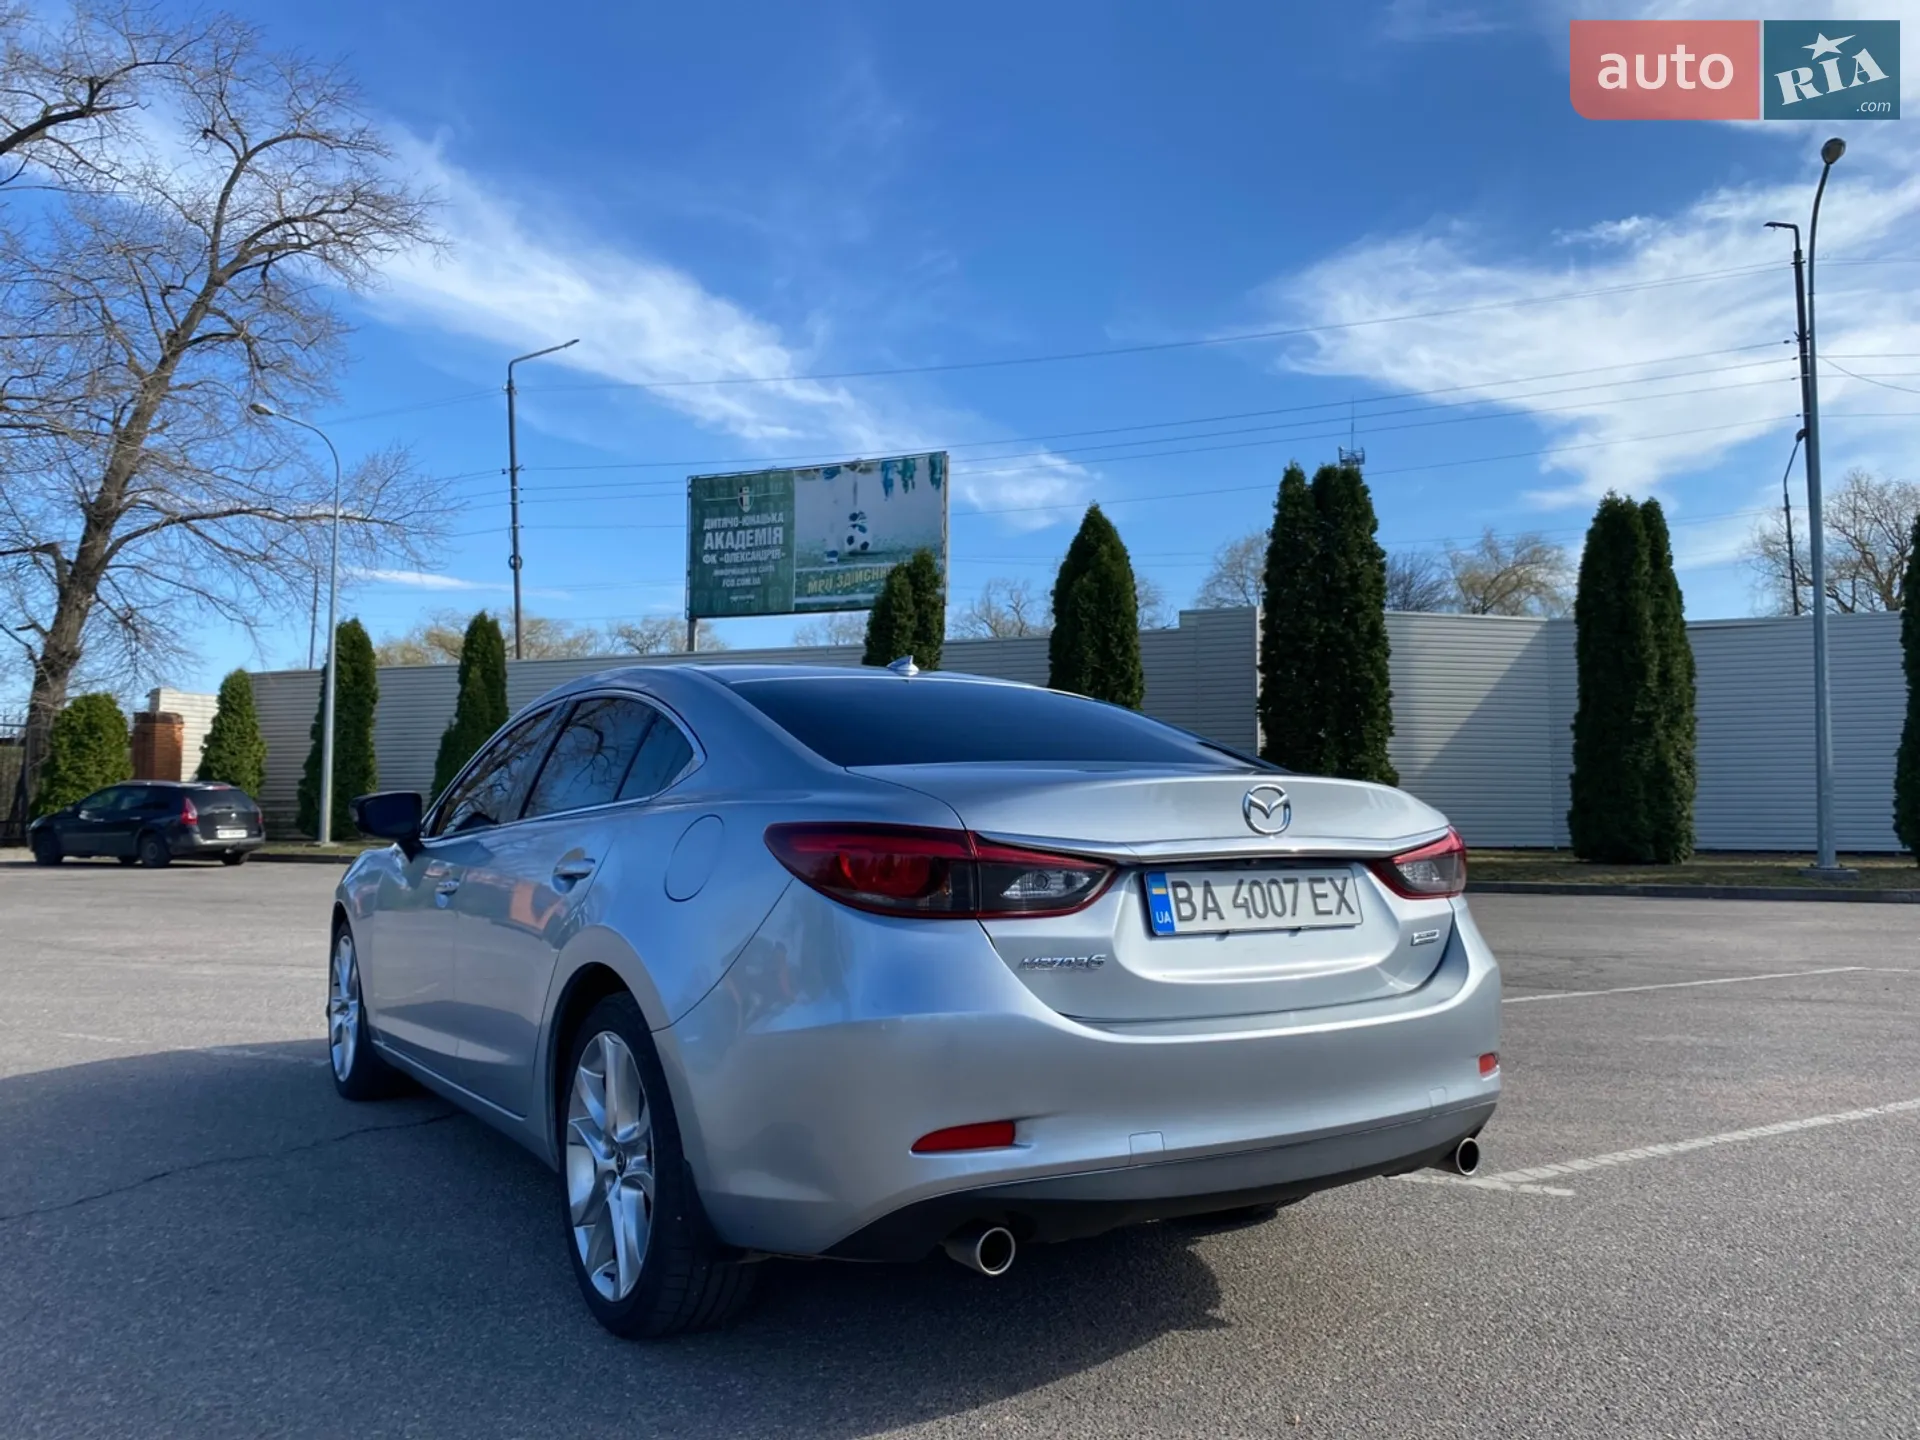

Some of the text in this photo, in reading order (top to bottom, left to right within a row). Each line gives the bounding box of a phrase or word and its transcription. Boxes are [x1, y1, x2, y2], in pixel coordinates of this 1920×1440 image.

[703, 526, 783, 551] АКАДЕМІЯ
[702, 553, 717, 565] ФК
[1171, 877, 1355, 922] BA 4007 EX
[1156, 910, 1172, 924] UA
